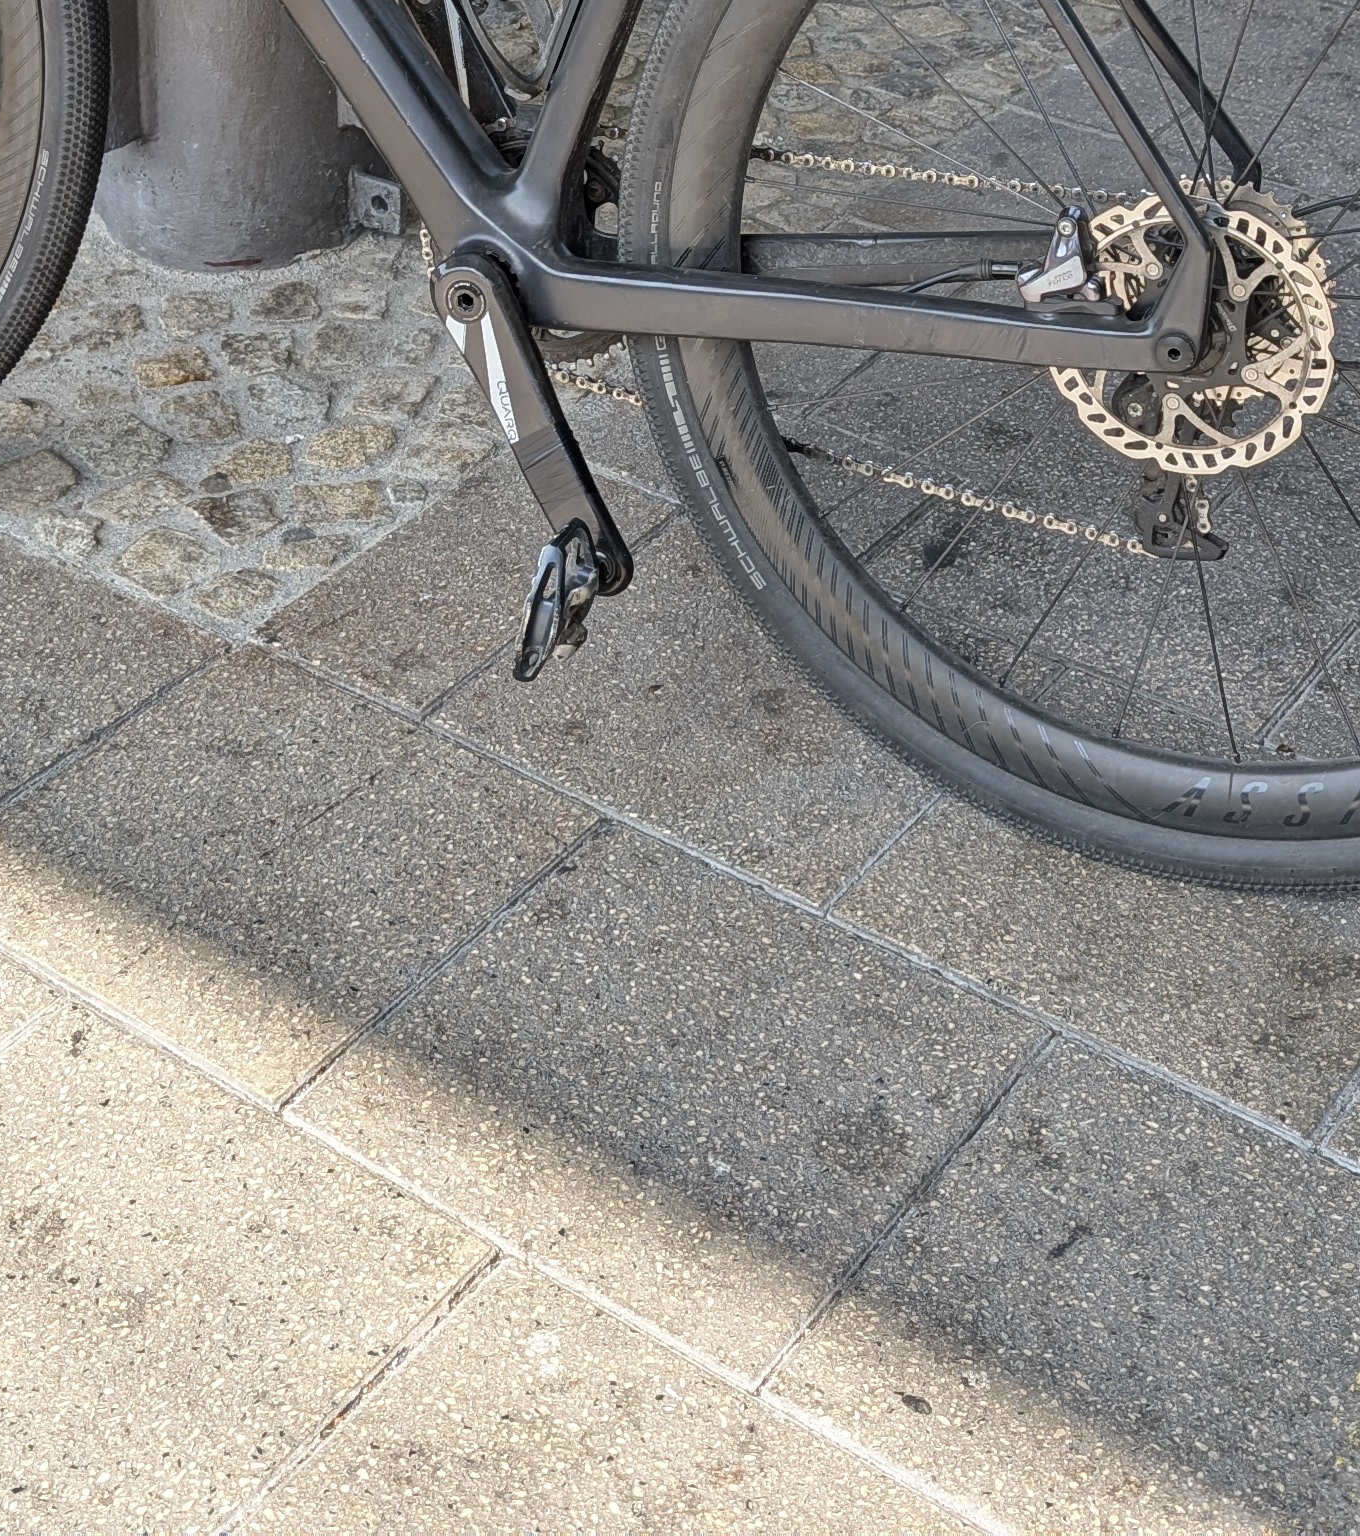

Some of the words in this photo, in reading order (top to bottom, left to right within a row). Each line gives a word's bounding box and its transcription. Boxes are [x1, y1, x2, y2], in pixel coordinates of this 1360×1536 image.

[10, 149, 50, 272] SCHWALBE
[650, 181, 662, 265] ALLROUND
[497, 380, 517, 441] QUARQ
[689, 454, 767, 590] SCHWALBE
